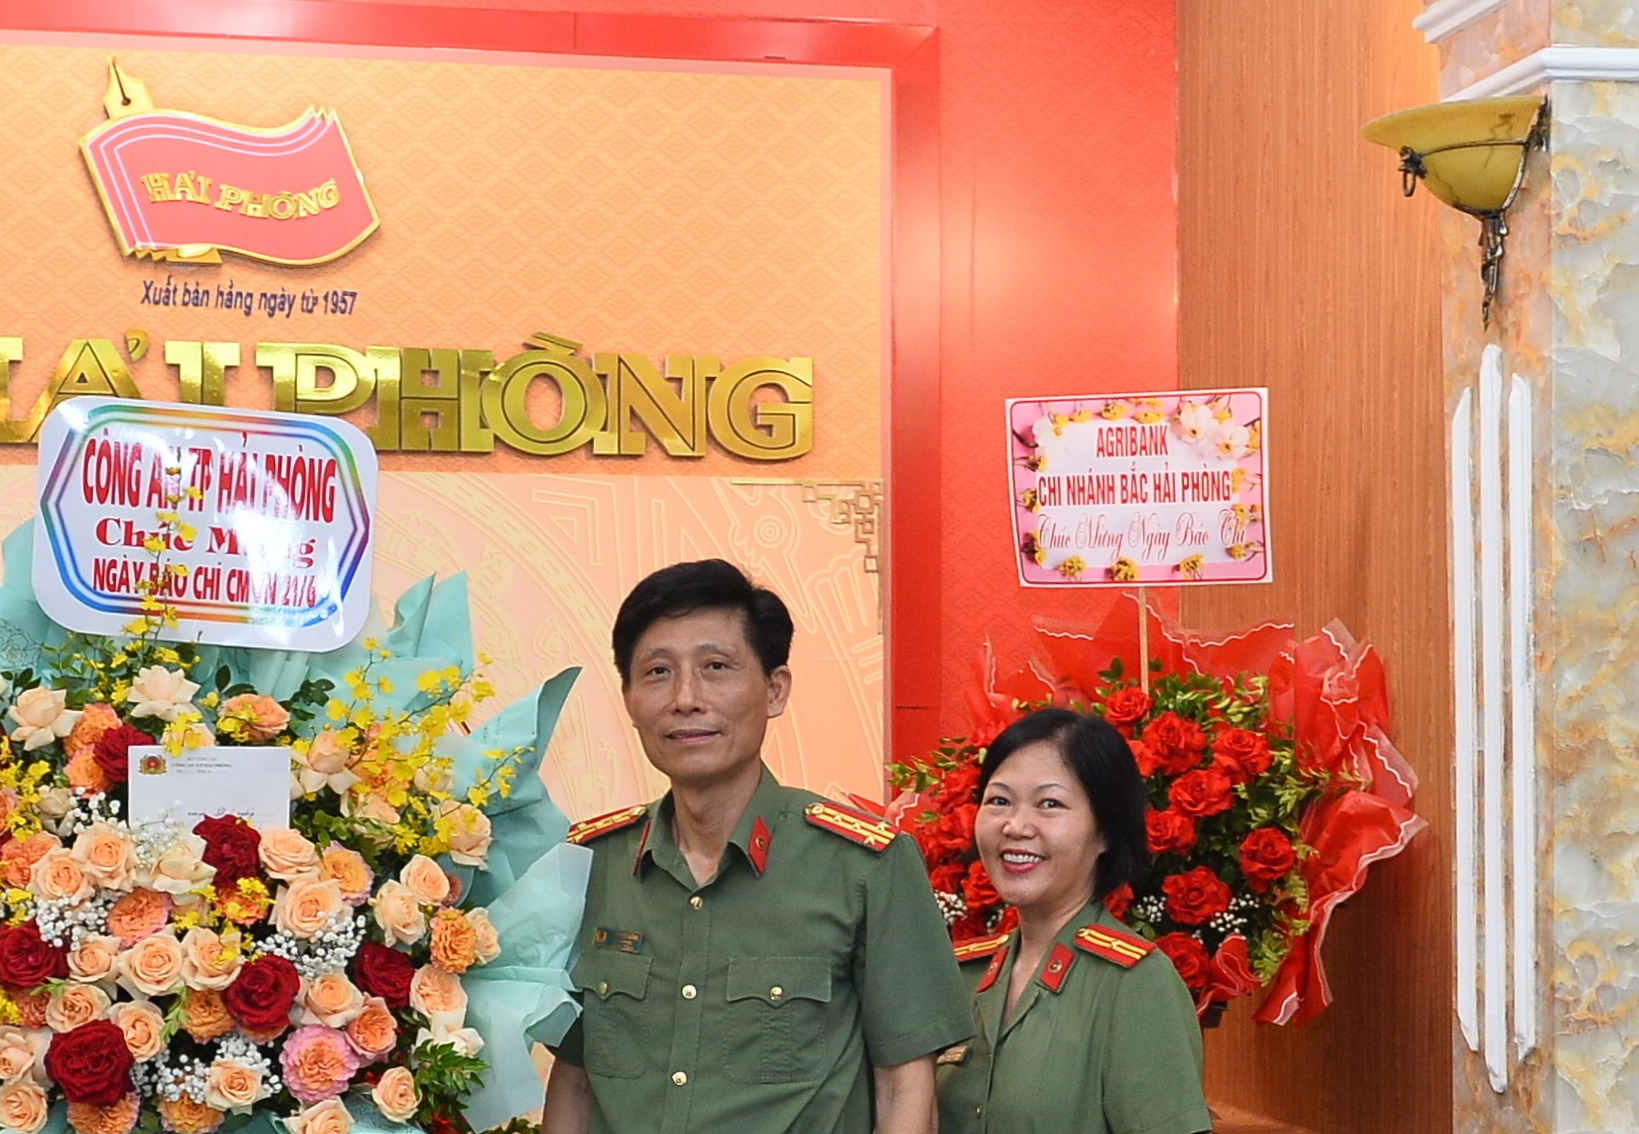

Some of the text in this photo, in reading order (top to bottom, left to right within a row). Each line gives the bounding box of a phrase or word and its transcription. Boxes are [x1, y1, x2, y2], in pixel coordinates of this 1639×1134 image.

[140, 170, 340, 220] HẢI PHÒNG
[140, 275, 178, 306] Xuất
[182, 281, 210, 307] bản
[258, 288, 296, 318] ngày
[301, 288, 318, 313] từ
[323, 290, 358, 315] 1957
[255, 331, 814, 460] PHÒNG
[1096, 425, 1169, 457] AGRIBANK
[82, 428, 143, 508] CÔNG
[1038, 461, 1231, 506] CHI NHÁNH BẮC HẢI PHÒNG
[95, 517, 194, 552] Chúc
[1036, 513, 1071, 549] Chúc
[1128, 511, 1170, 563] Ngày
[1175, 511, 1209, 546] Báo
[92, 554, 145, 594] NGÀY
[149, 558, 188, 598] BÁO
[192, 562, 223, 601] CHÍ
[226, 568, 278, 605] CMN
